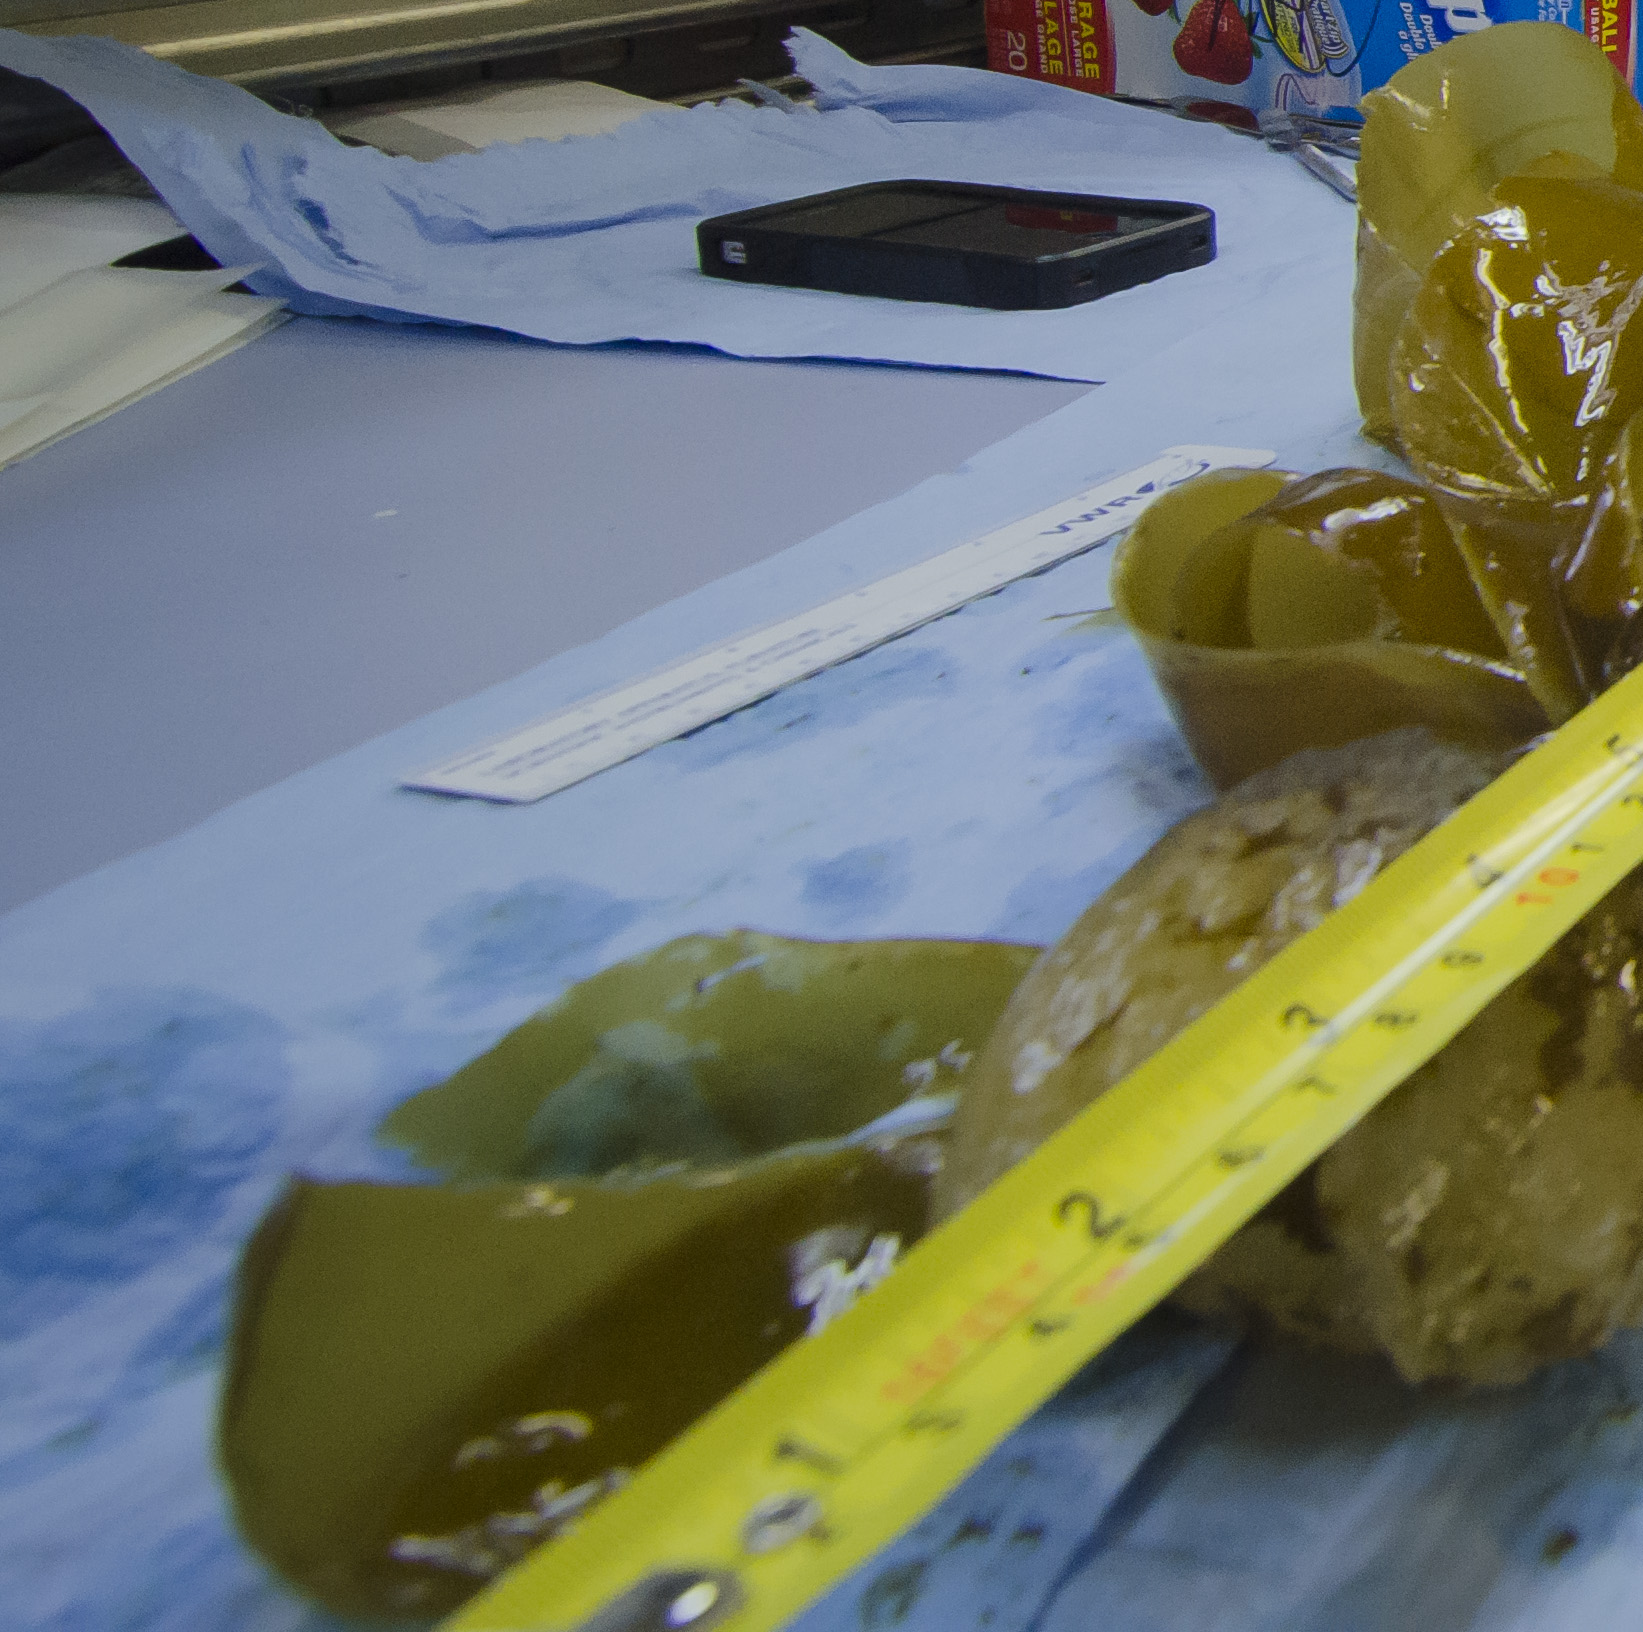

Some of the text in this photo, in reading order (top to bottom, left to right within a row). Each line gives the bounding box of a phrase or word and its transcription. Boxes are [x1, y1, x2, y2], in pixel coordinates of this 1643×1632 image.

[1590, 8, 1599, 43] USAG
[1006, 30, 1028, 72] 20
[1037, 24, 1048, 74] GRAND
[1071, 30, 1085, 78] LARGE
[1040, 494, 1140, 536] VWR
[1514, 866, 1582, 908] 10
[1057, 1189, 1125, 1240] 2
